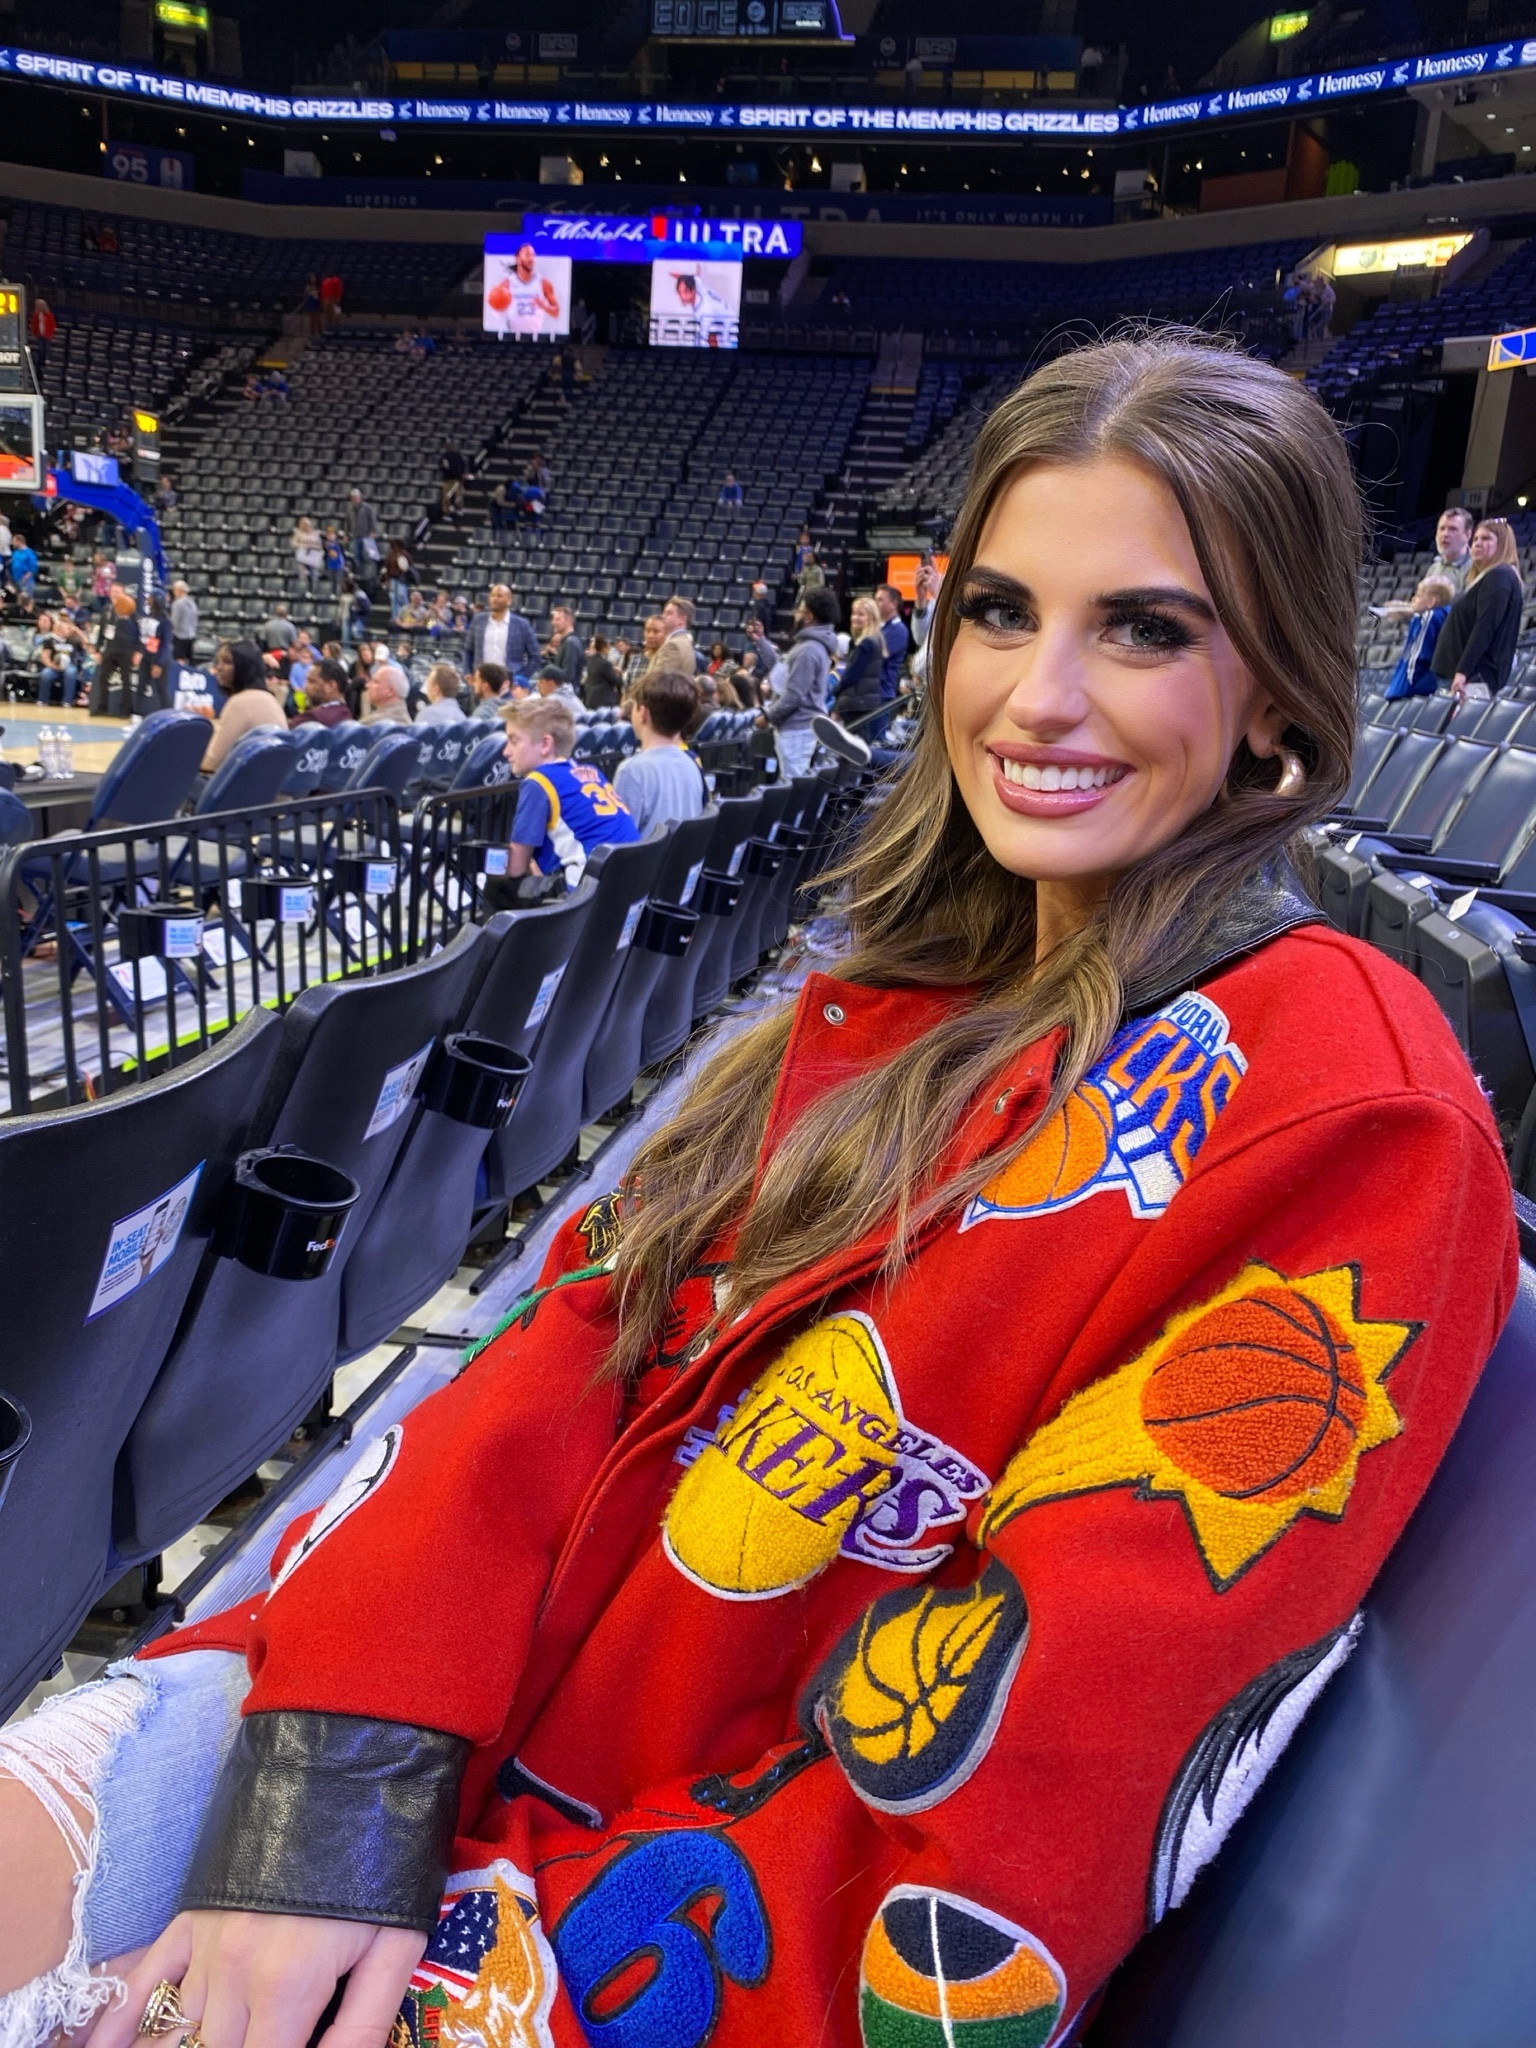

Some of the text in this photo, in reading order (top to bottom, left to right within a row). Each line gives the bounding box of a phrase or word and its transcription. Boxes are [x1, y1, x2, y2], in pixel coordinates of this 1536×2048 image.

[1416, 51, 1489, 78] Hennessy
[16, 53, 395, 119] SPIRIT OF THE MEMPHIS GRIZZLIES
[1318, 69, 1386, 95] Hennessy
[1227, 85, 1291, 110] Hennessy
[416, 101, 472, 121] Hennessy
[495, 101, 551, 123] Hennessy
[575, 103, 632, 124] Hennessy
[656, 105, 714, 126] Hennessy
[739, 107, 1120, 133] SPIRIT OF THE MEMPHIS GRIZZLIES
[1143, 101, 1203, 125] Hennessy
[112, 154, 149, 182] 95
[955, 211, 997, 224] ONLY
[1004, 212, 1061, 225] WORTH
[111, 1222, 150, 1254] IN-SEAT
[306, 1238, 337, 1251] FedE
[107, 1236, 146, 1268] MOBILE
[808, 1388, 984, 1493] ANGELES
